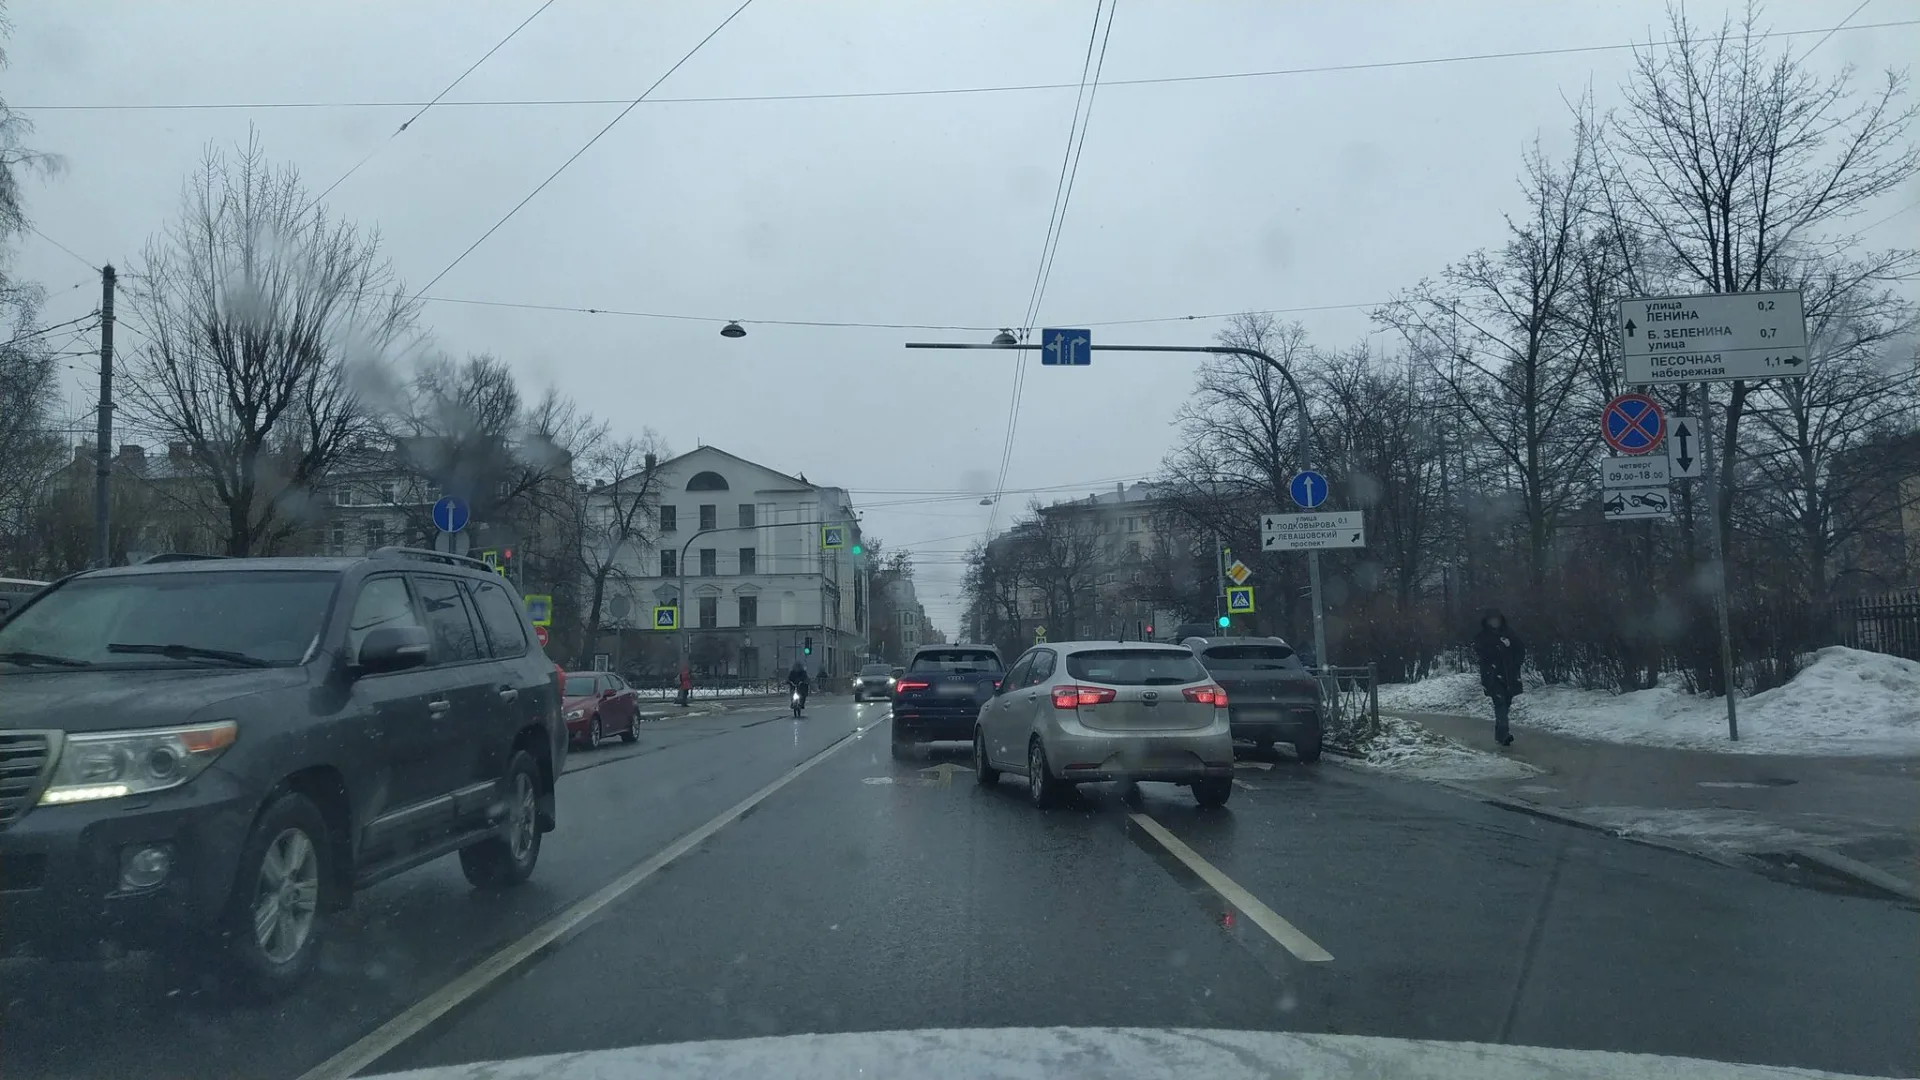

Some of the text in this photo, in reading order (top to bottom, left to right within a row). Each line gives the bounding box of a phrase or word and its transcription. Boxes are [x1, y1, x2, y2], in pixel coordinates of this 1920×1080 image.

[1645, 301, 1682, 313] улица
[1757, 301, 1775, 312] 0,2
[1646, 310, 1700, 322] ЛЕНИНА
[1647, 326, 1733, 340] Б. ЗЕЛЕНИНА
[1760, 328, 1777, 339] 0,7
[1648, 340, 1686, 352] улица
[1650, 353, 1722, 367] ПЕСОЧНАЯ
[1764, 356, 1781, 368] 1,1
[1651, 366, 1725, 380] набережная
[1618, 462, 1652, 470] четверг
[1276, 521, 1337, 531] ПОДКОВЫРОВА
[1295, 516, 1317, 525] улица
[1277, 531, 1338, 540] ЛЕВАШОВСКИЙ
[1290, 540, 1326, 548] проспект
